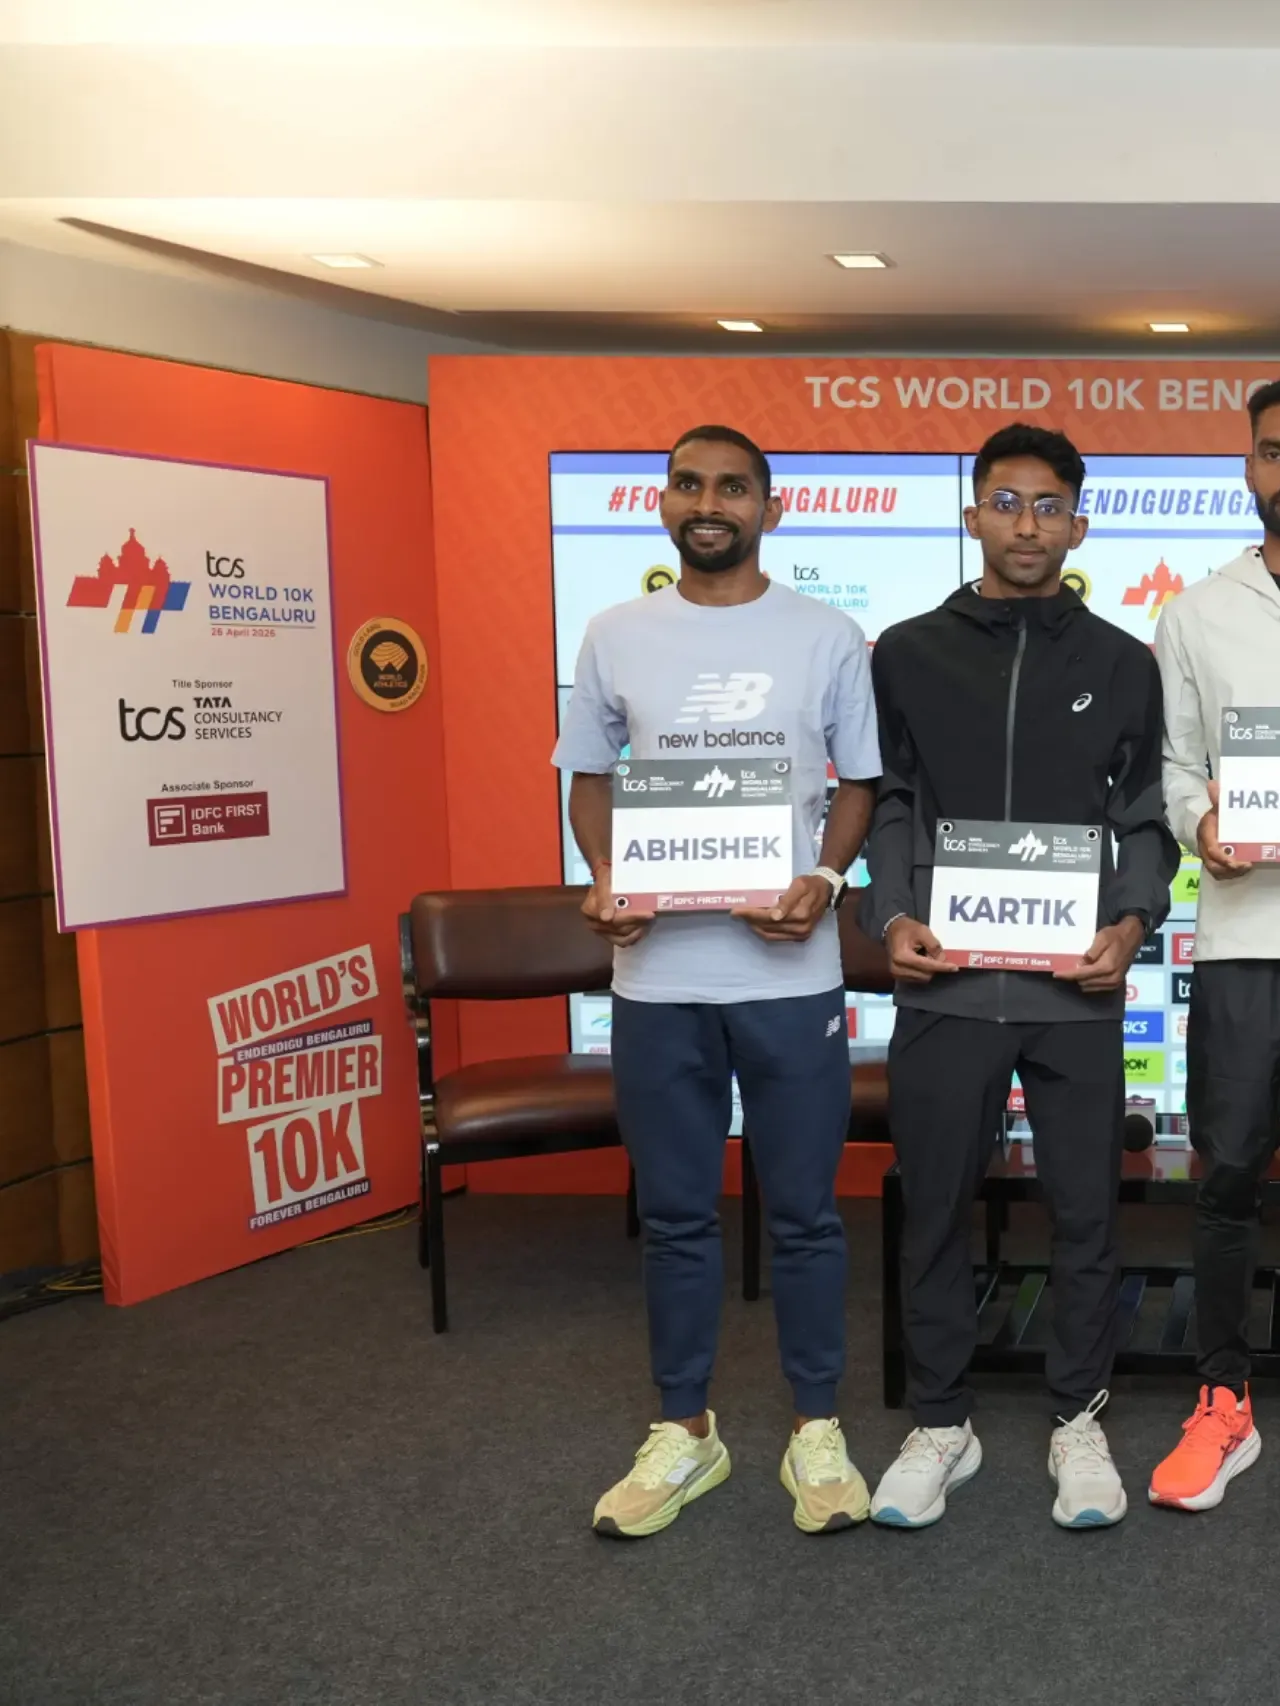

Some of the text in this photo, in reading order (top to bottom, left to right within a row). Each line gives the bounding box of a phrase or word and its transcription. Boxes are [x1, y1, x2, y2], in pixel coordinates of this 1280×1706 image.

[805, 376, 880, 409] TCS
[894, 377, 1051, 410] WORLD
[1068, 378, 1144, 410] 10K
[206, 551, 245, 579] tcs
[793, 564, 820, 581] tcs
[208, 583, 314, 603] WORLD 10K
[795, 584, 868, 595] WORLD 10K
[829, 598, 869, 608] ALURU
[209, 605, 316, 623] BENGALURU
[226, 629, 250, 639] April
[172, 679, 233, 690] Title Sponsor
[193, 697, 232, 709] TATA
[118, 697, 187, 742] tcs
[194, 711, 283, 725] CONSULTANCY
[195, 727, 252, 740] SERVICES
[658, 728, 786, 749] new balance
[1229, 725, 1253, 740] tcs
[161, 779, 254, 793] Associate Sponsor
[623, 778, 647, 792] tcs
[191, 804, 262, 820] IDFC FIRST
[192, 822, 225, 836] Bank
[623, 836, 781, 862] ABHISHEK
[943, 836, 967, 851] tcs
[674, 895, 747, 905] IDFC FIRST Bank
[949, 895, 1077, 927] KARTIK
[984, 957, 1003, 965] IDFC
[1005, 957, 1029, 965] FIRST
[1123, 1020, 1148, 1034] SICS
[237, 1022, 371, 1061] ENDENDIGU BENGALURU
[222, 1044, 378, 1114] PREMIER
[254, 1102, 361, 1204] 10K
[250, 1181, 369, 1229] FOREVER BENGALURU
